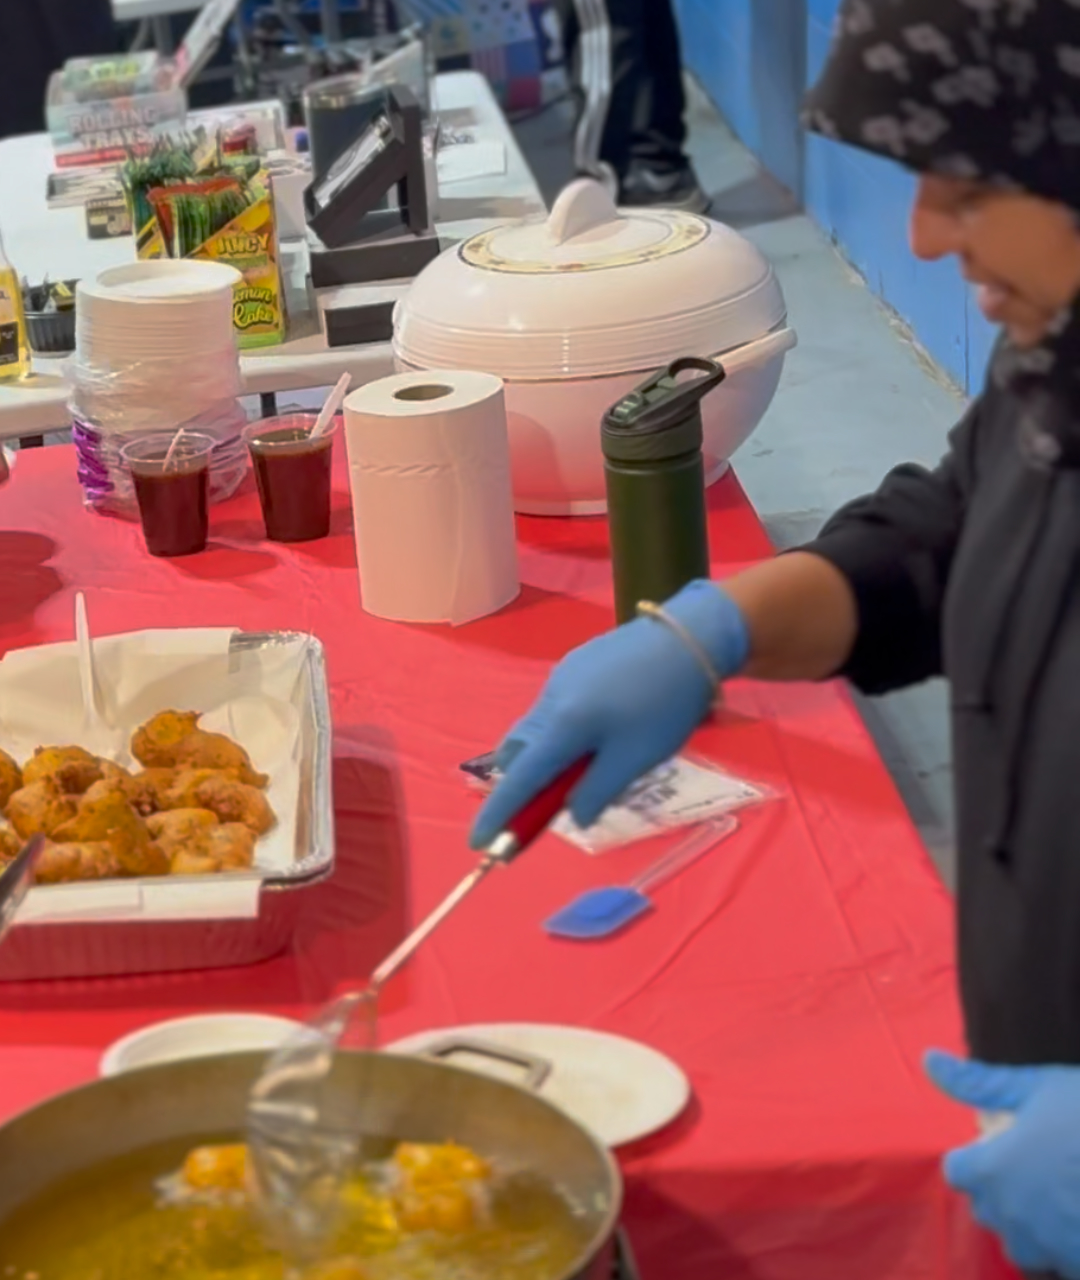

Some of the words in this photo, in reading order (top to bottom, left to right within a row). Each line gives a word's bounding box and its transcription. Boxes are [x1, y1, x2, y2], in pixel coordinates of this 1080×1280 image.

[67, 105, 157, 134] ROLLING
[80, 125, 154, 150] TRAYS
[216, 231, 270, 256] JUICY
[234, 286, 273, 304] emon
